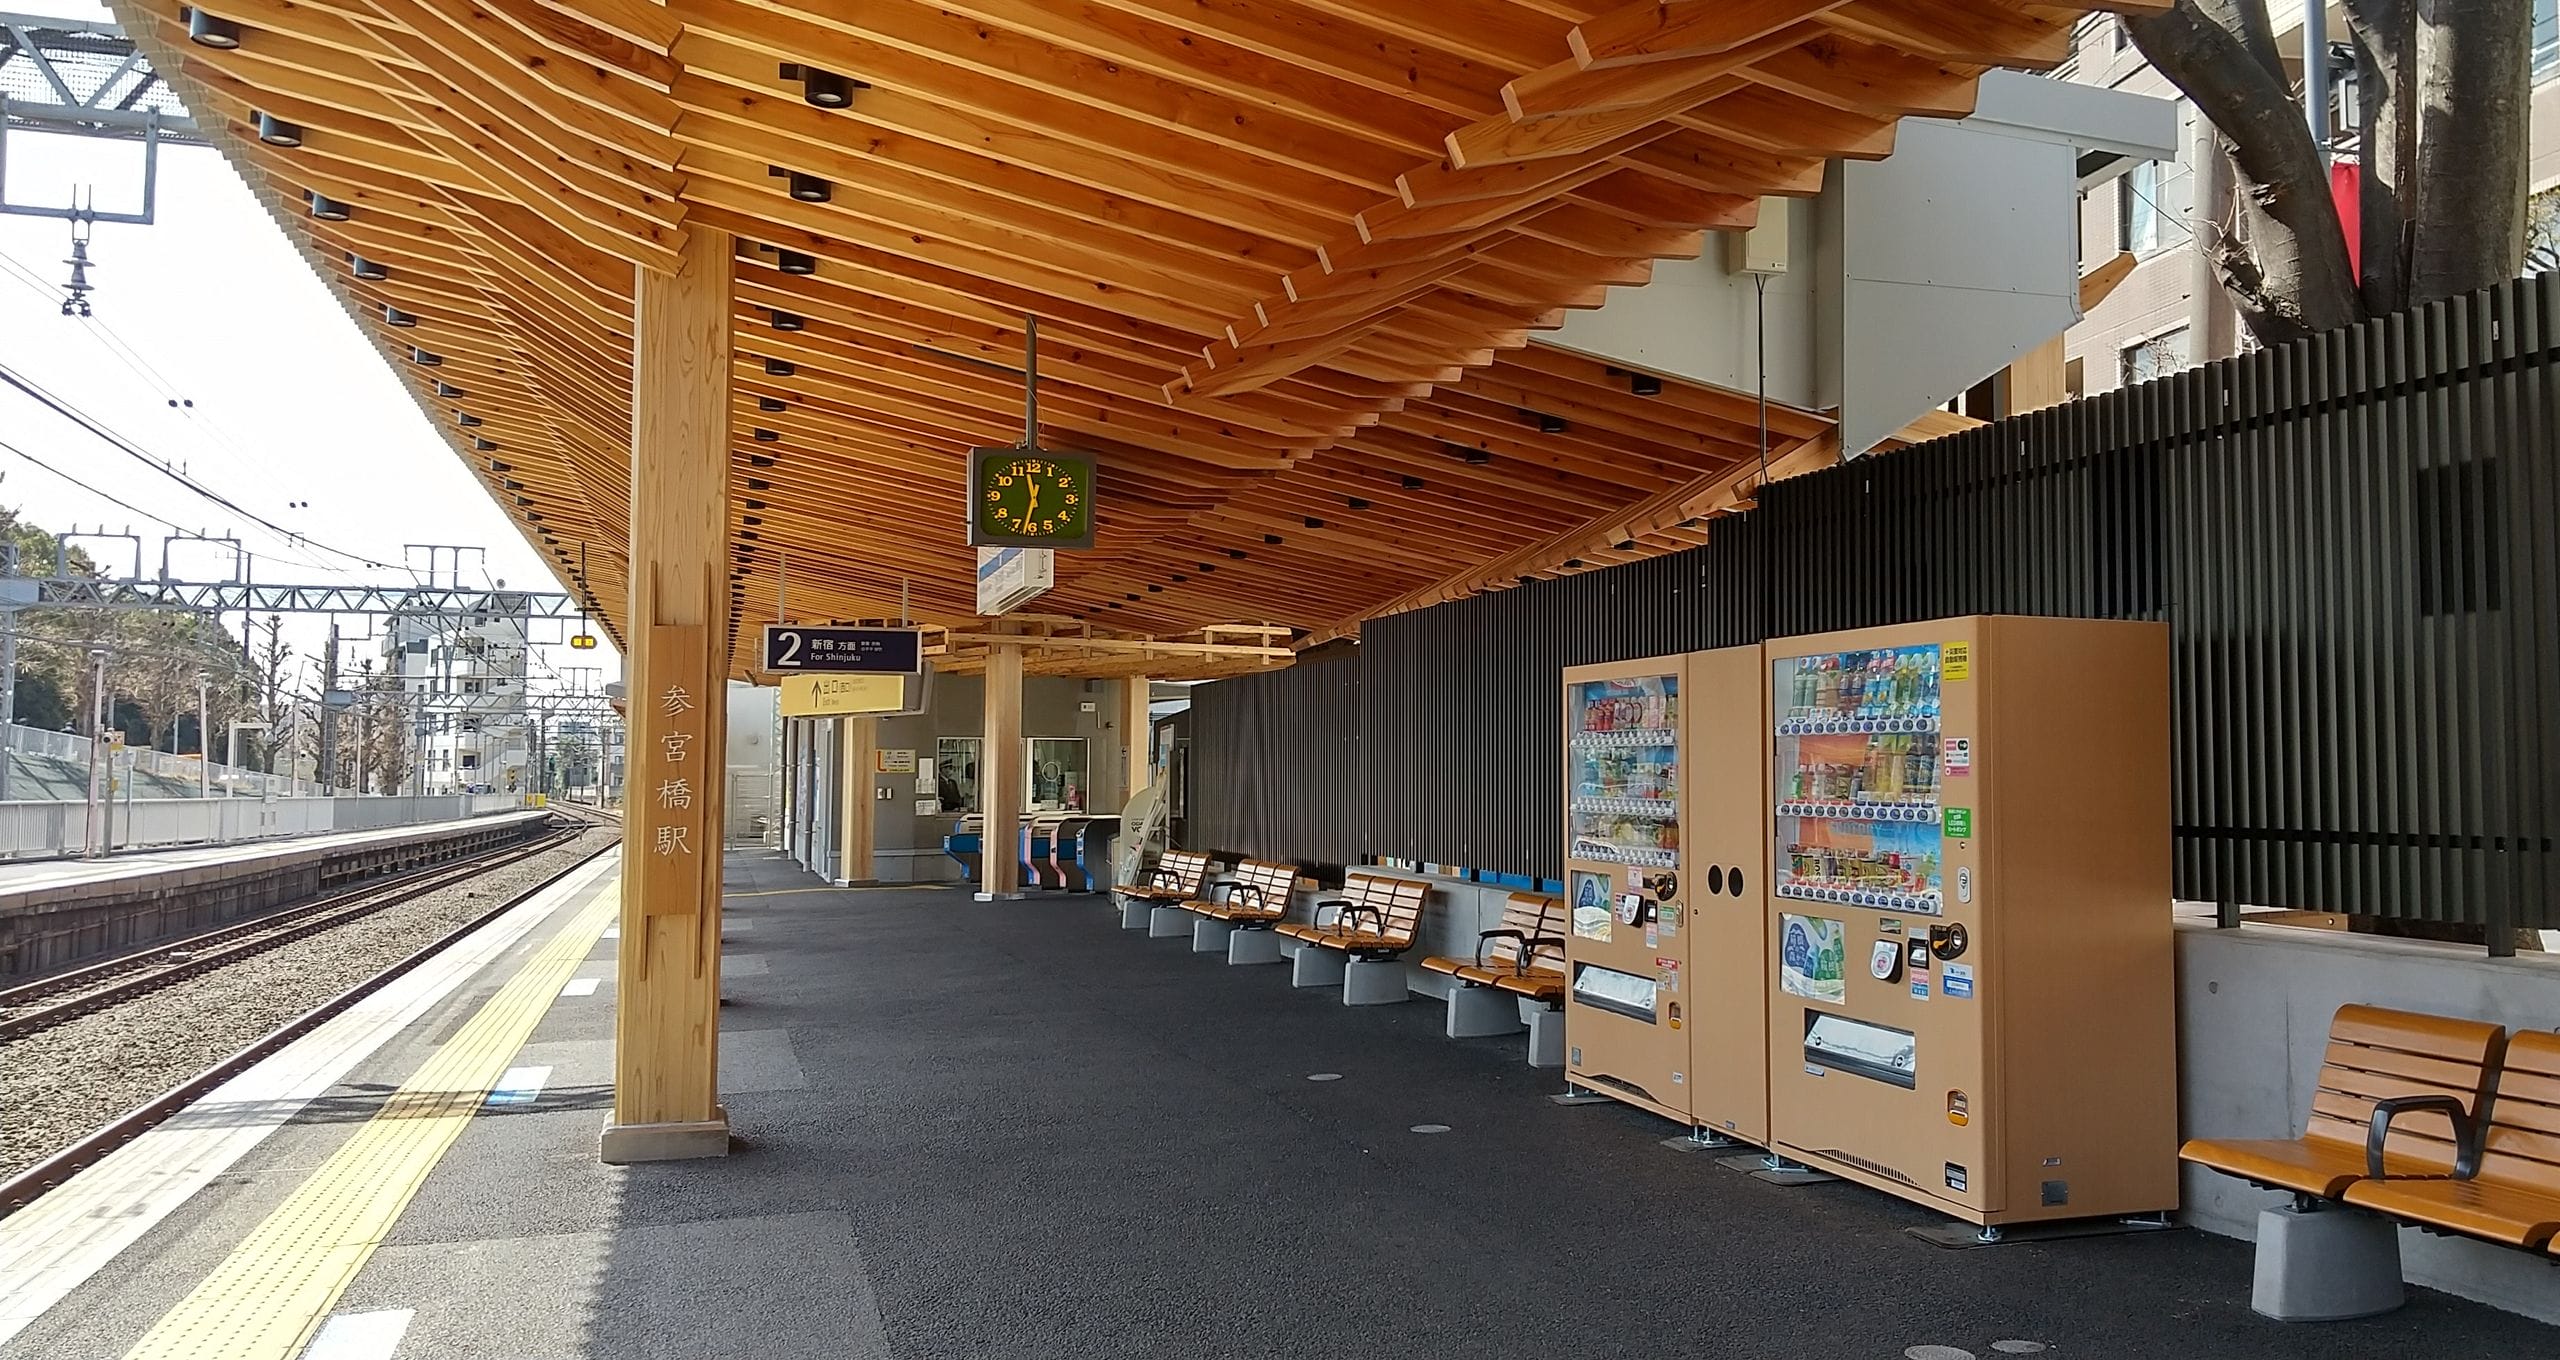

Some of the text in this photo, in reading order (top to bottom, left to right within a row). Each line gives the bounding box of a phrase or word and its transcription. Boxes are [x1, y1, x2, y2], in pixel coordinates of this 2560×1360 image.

[1012, 466, 1025, 477] 11
[1026, 462, 1041, 473] 12
[1047, 466, 1053, 477] 1
[998, 476, 1012, 486] 10
[1058, 477, 1069, 488] 2
[990, 490, 1001, 501] 9
[1065, 494, 1075, 504] 3
[998, 508, 1008, 518] 8
[1057, 510, 1068, 520] 4
[1012, 518, 1022, 529] 7
[1028, 522, 1038, 533] 6
[1043, 520, 1053, 530] 5
[777, 631, 802, 666] 2
[811, 638, 834, 650] 新宿
[838, 641, 856, 651] 方面
[810, 652, 861, 663] For Shinjuku
[823, 680, 838, 695] 出口
[653, 685, 695, 857] 参宮橋駅
